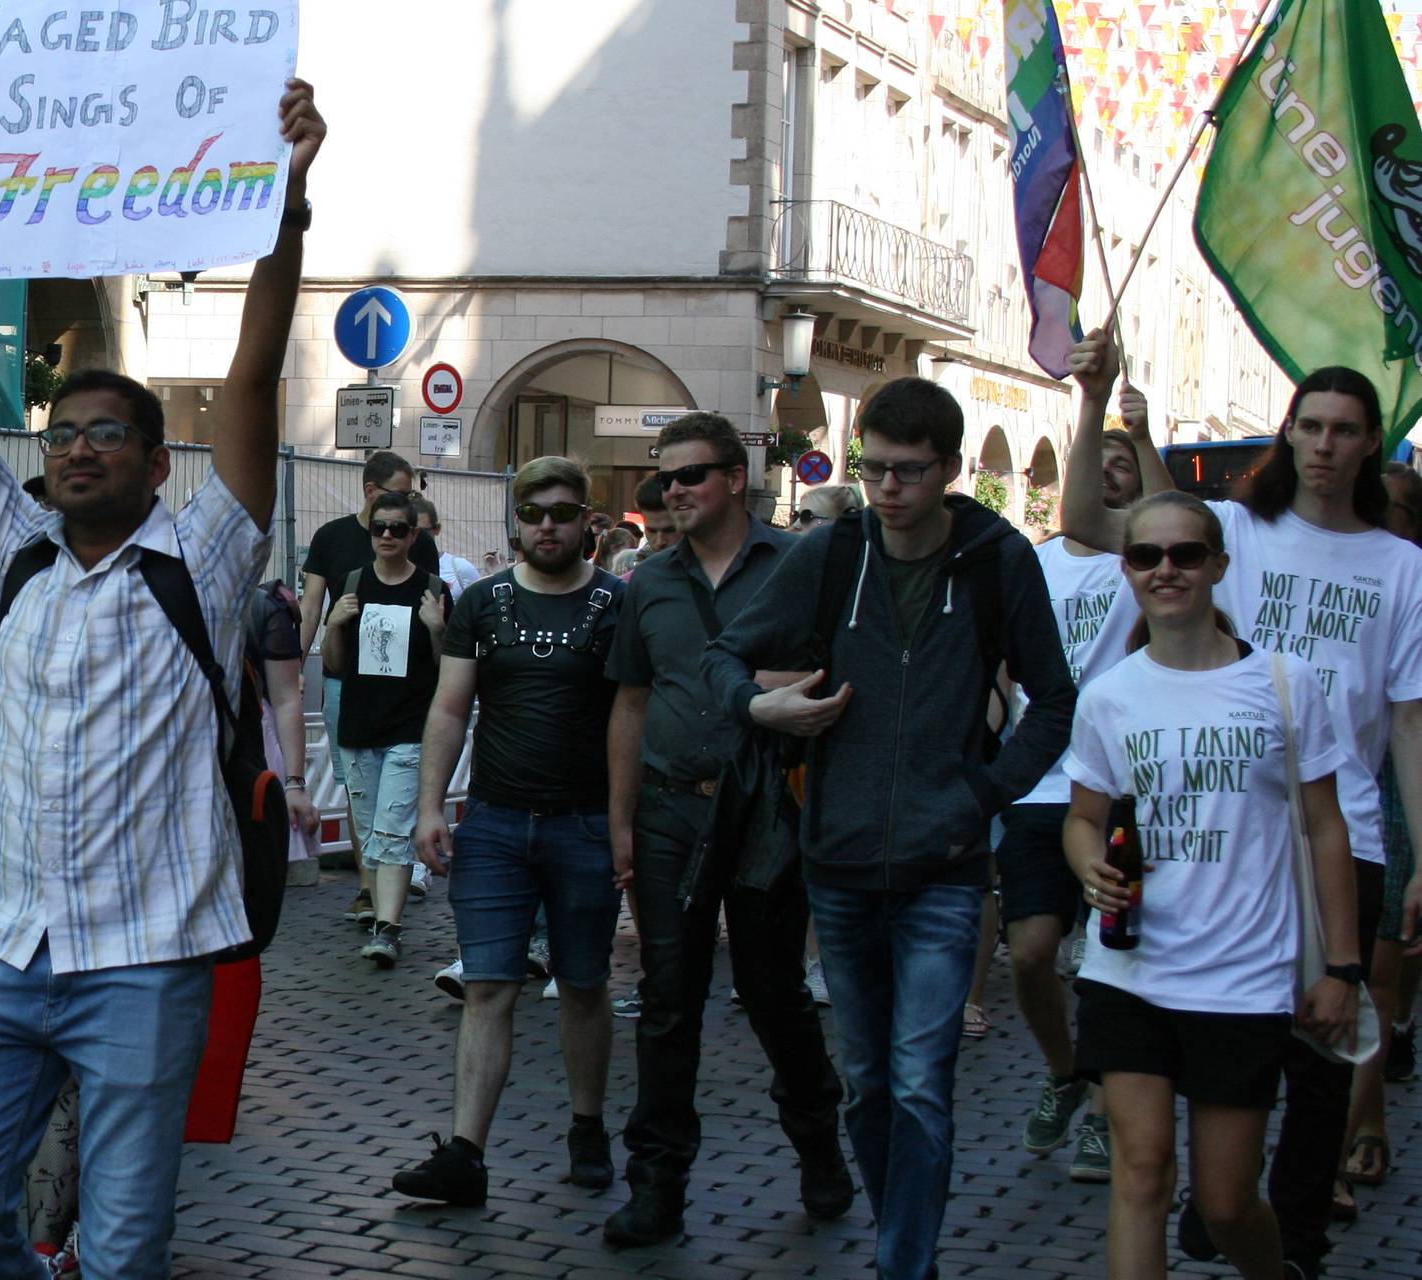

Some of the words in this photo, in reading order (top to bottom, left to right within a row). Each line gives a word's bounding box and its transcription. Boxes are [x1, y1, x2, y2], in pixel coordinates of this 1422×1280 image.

[151, 0, 279, 51] BIRD
[175, 75, 228, 119] OF
[347, 416, 358, 426] und
[599, 416, 638, 425] TOMMY
[355, 433, 371, 443] frei
[1260, 570, 1300, 601] NOT
[1066, 619, 1106, 645] MOR
[1255, 600, 1297, 631] ANY
[1305, 607, 1362, 643] MORE
[1125, 728, 1166, 765] NOT
[1133, 760, 1167, 797] ANY
[1182, 759, 1251, 793] MORE
